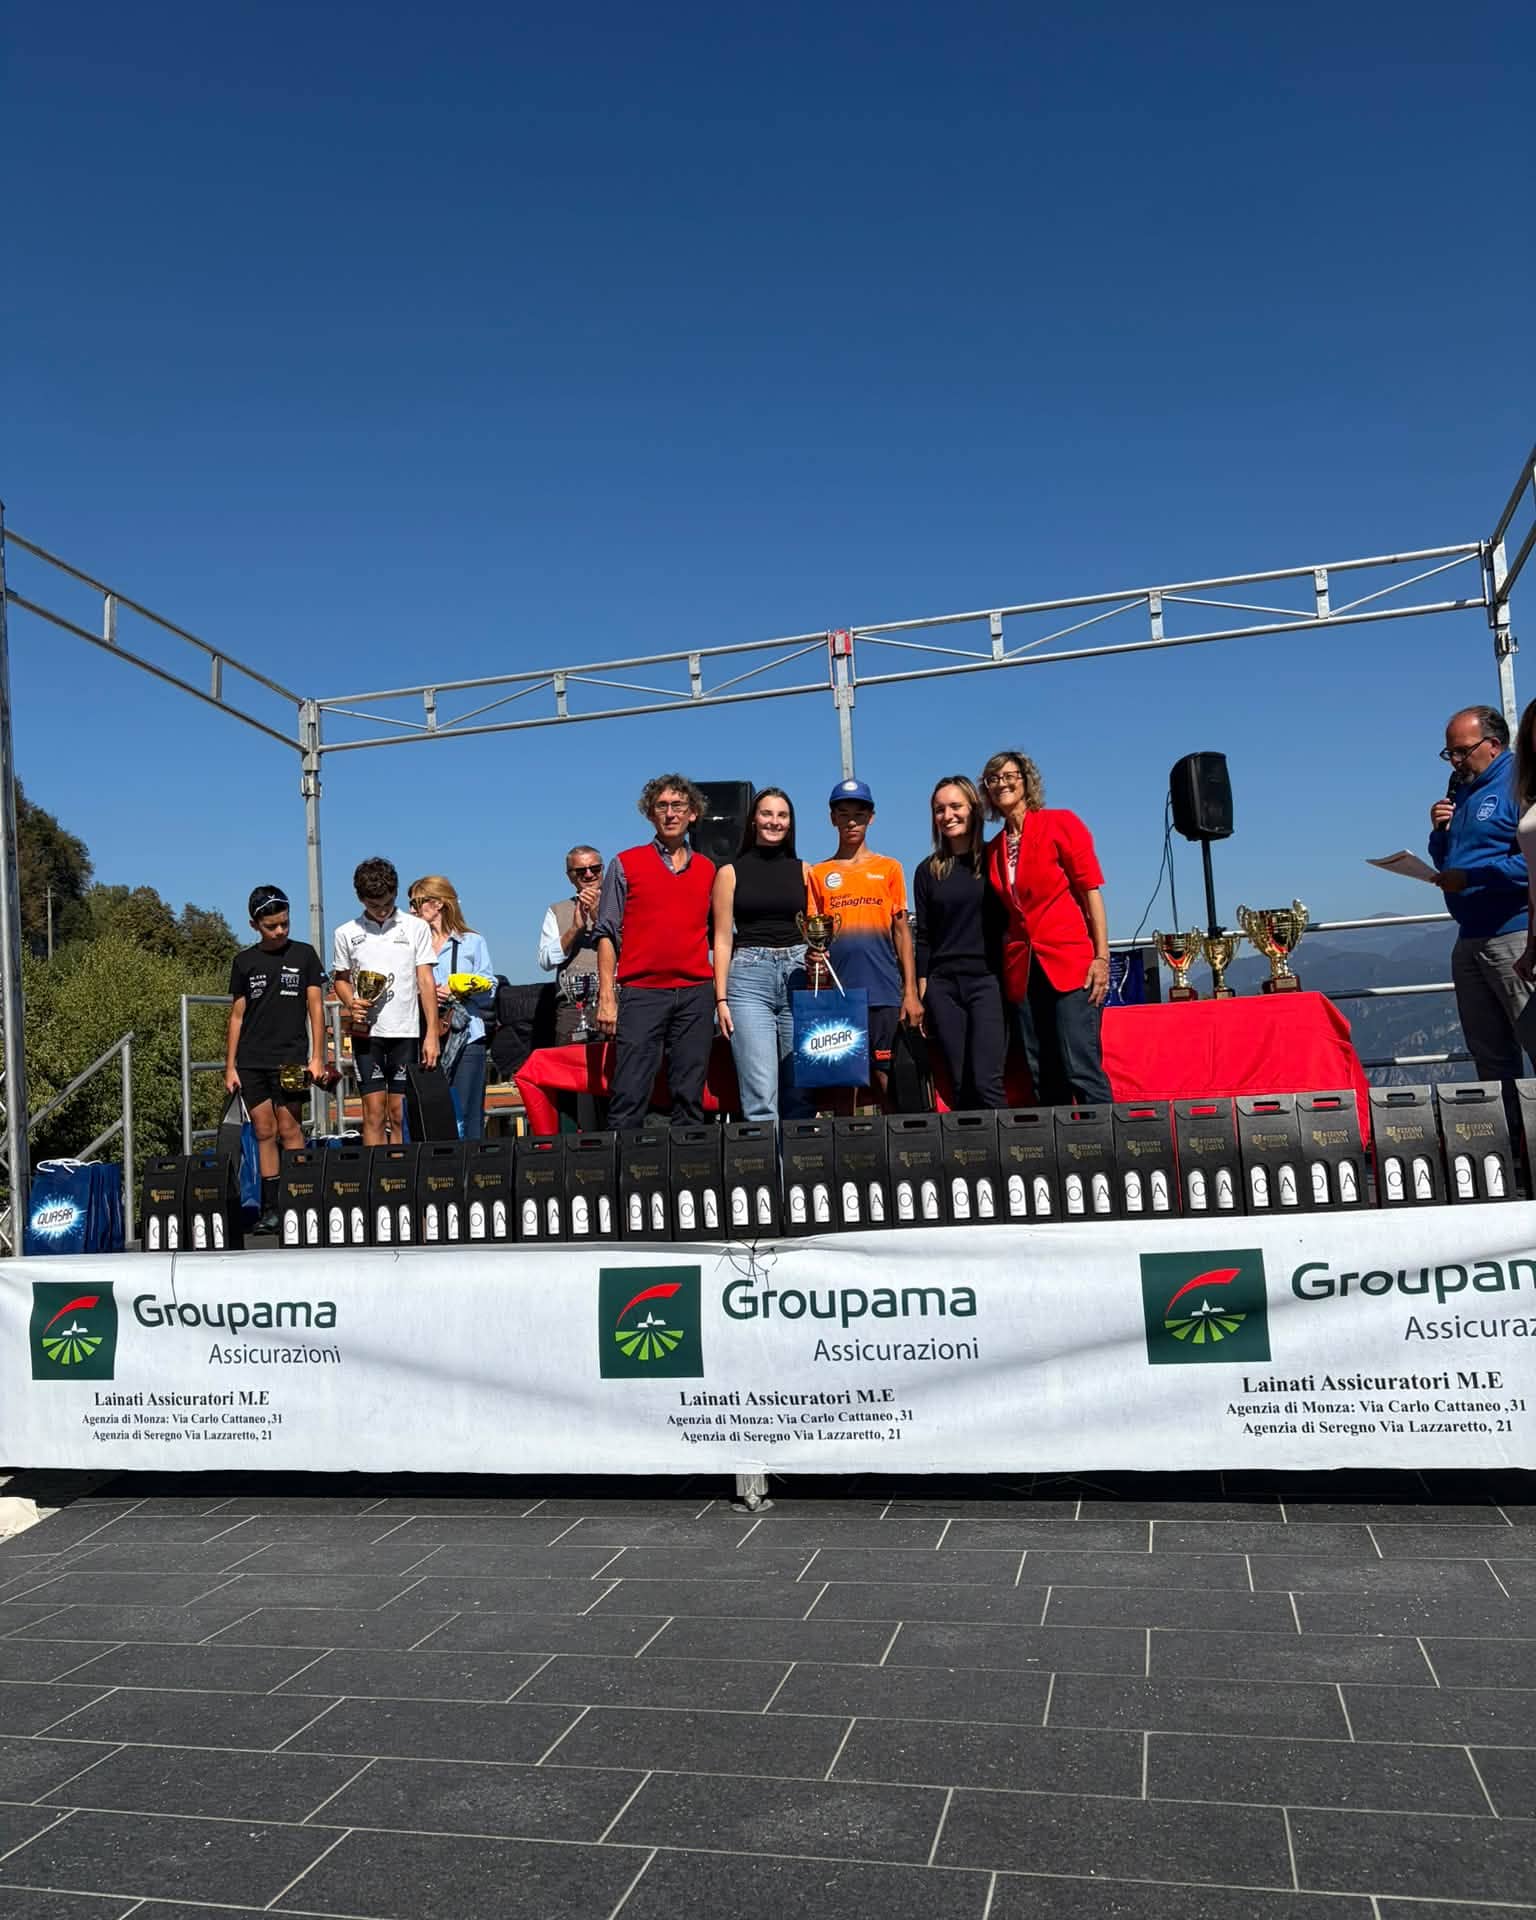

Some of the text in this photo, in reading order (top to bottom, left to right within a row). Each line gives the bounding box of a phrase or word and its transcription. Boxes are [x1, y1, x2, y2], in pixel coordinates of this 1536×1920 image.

[811, 1030, 852, 1050] QUASAR
[37, 1207, 74, 1225] QUASAR
[722, 1280, 976, 1328] Groupama
[133, 1294, 336, 1335] Groupama
[209, 1344, 340, 1364] Assicurazioni
[814, 1337, 978, 1361] Assicurazioni
[1243, 1372, 1503, 1392] Lainati Assicuratori M.E
[95, 1391, 269, 1406] Lainati Assicuratori M.E
[680, 1389, 894, 1406] Lainati Assicuratori M.E
[1227, 1402, 1280, 1417] Agenzia
[1285, 1402, 1297, 1413] di
[1303, 1401, 1355, 1413] Monza:
[1360, 1401, 1383, 1412] Via
[1389, 1400, 1429, 1412] Carlo
[82, 1414, 119, 1425] Agenzia
[122, 1414, 130, 1424] di
[134, 1414, 168, 1424] Monza:
[172, 1414, 188, 1423] Via
[191, 1414, 218, 1424] Carlo
[667, 1415, 711, 1426] Agenzia
[715, 1415, 726, 1424] di
[730, 1415, 773, 1424] Monza:
[777, 1414, 797, 1424] Via
[801, 1413, 834, 1423] Carlo
[1243, 1420, 1512, 1436] Agenzia di Seregno Via Lazzaretto, 21
[93, 1430, 271, 1442] Agenzia di Seregno Via Lazzaretto, 21
[682, 1428, 900, 1443] Agenzia di Seregno Via Lazzaretto, 21
